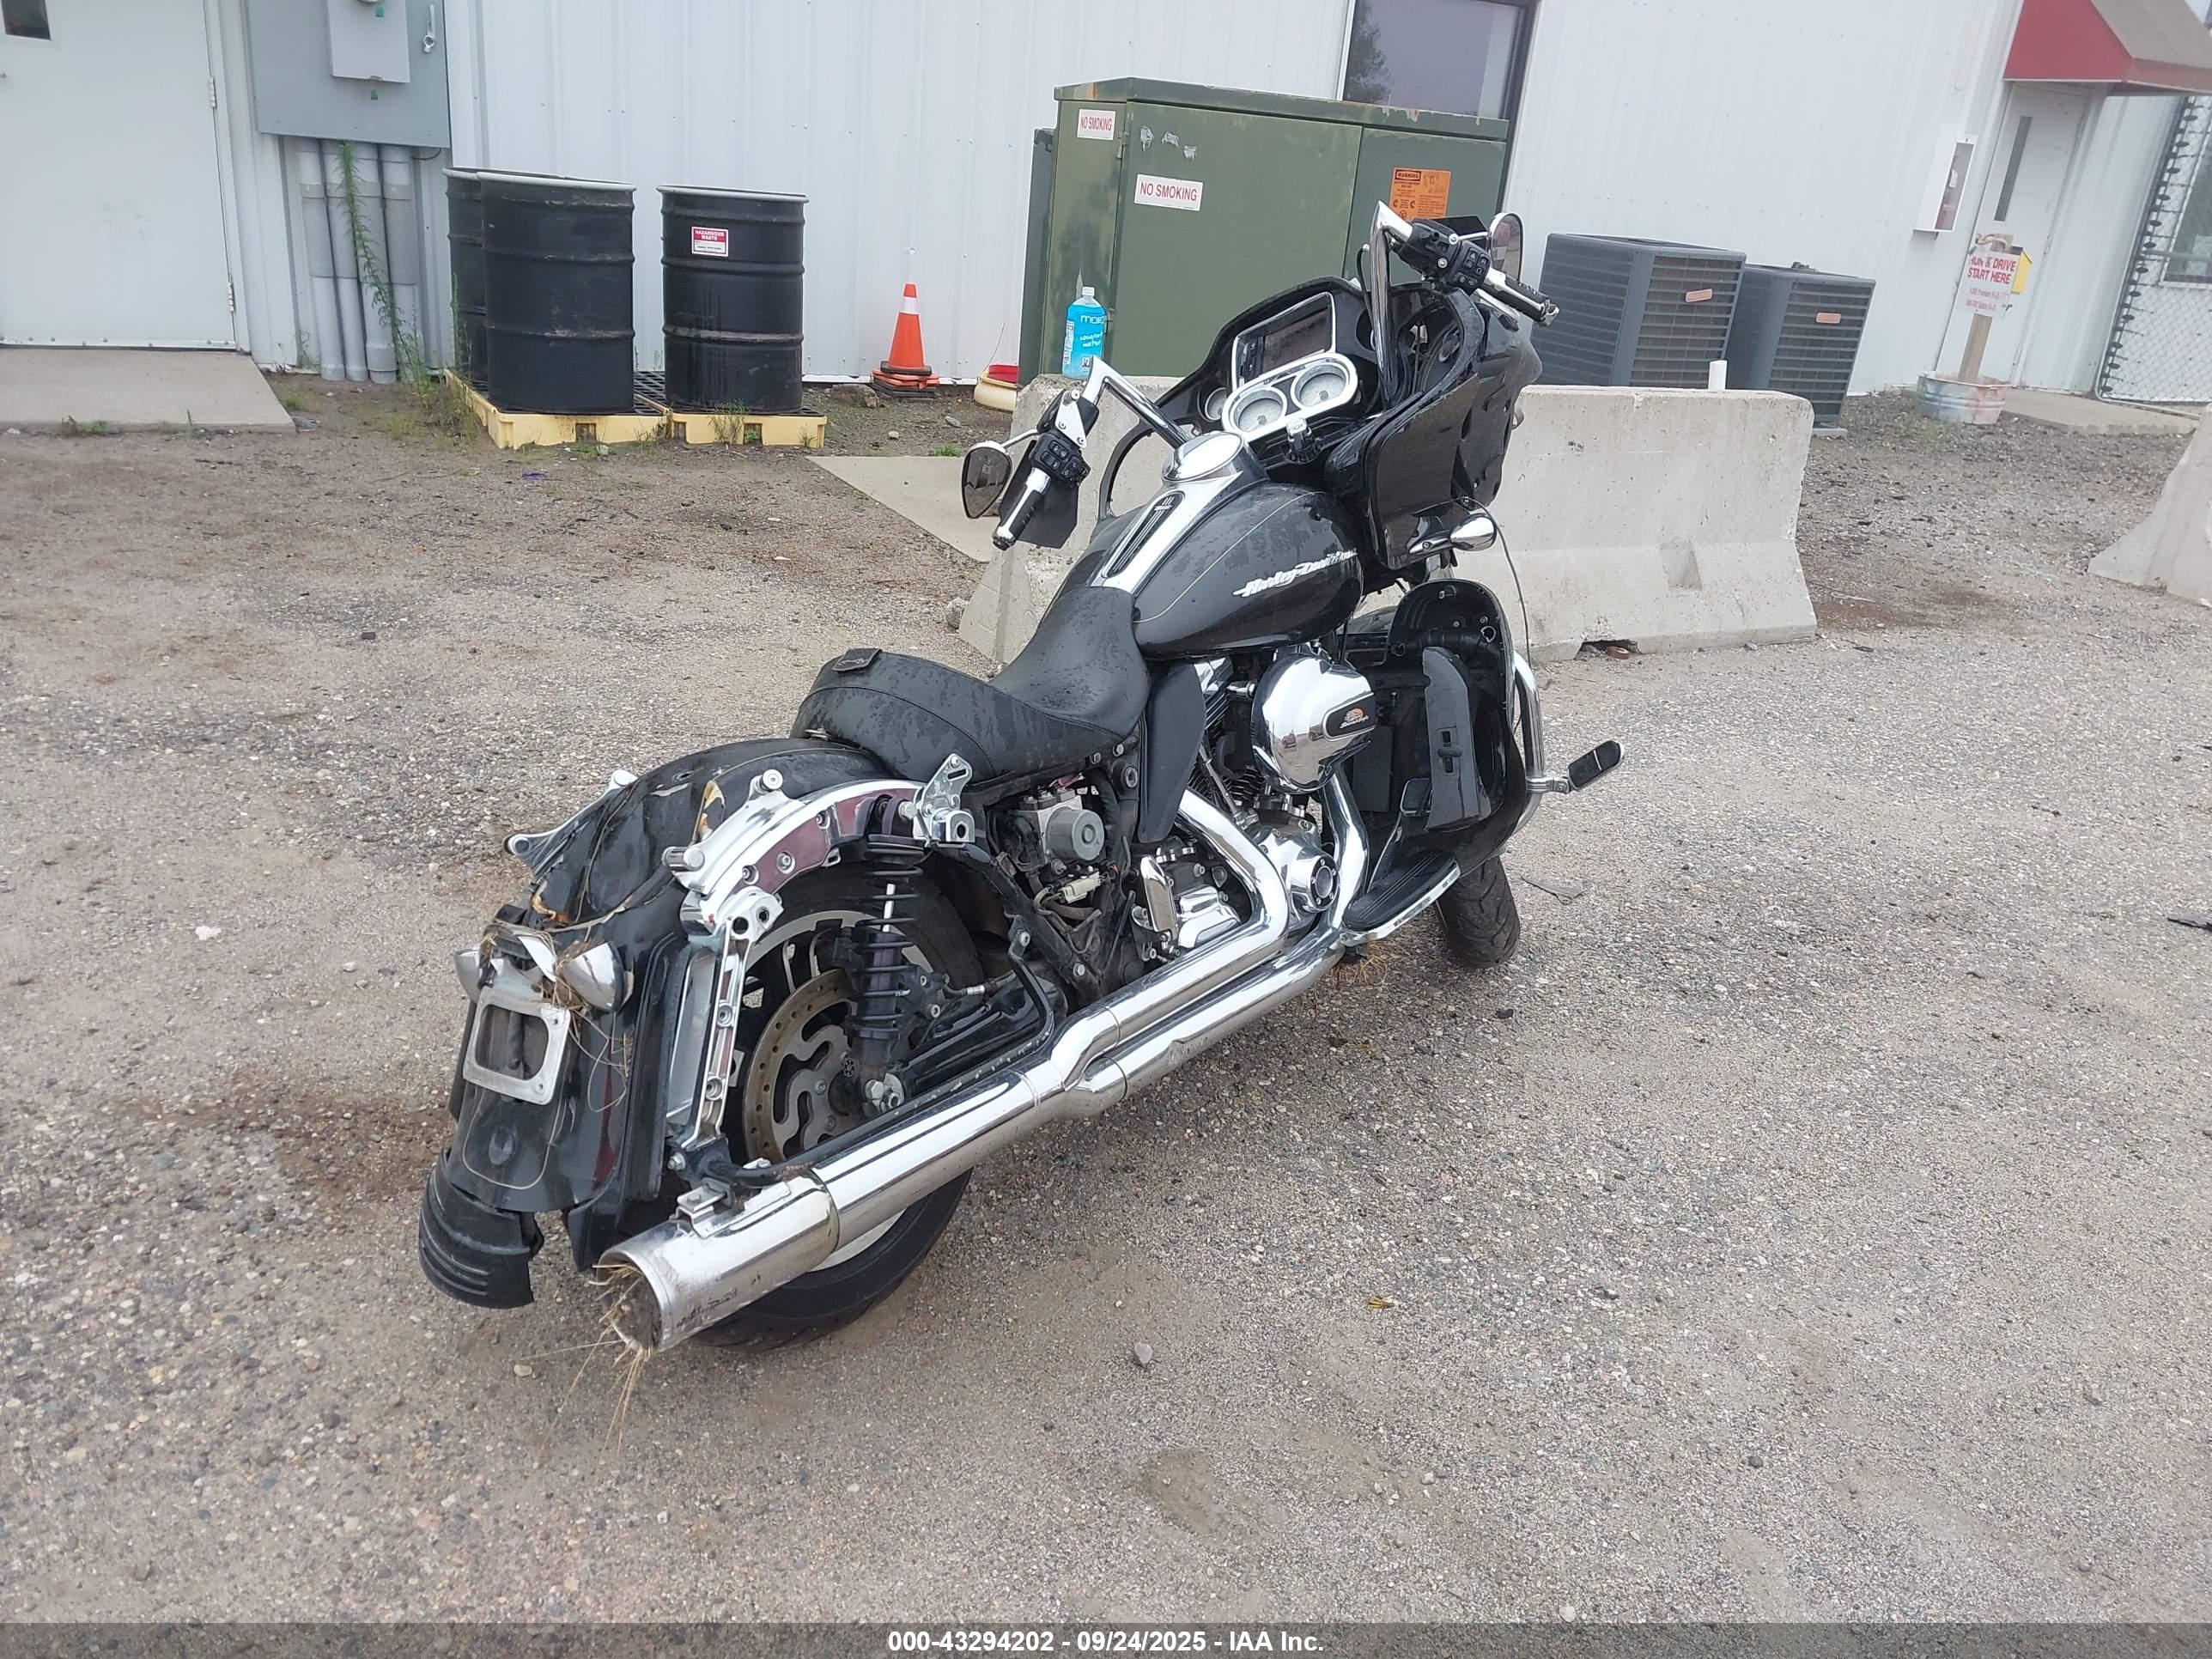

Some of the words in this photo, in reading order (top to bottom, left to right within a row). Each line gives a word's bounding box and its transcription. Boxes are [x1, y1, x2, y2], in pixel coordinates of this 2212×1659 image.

[1080, 116, 1088, 129] NO
[1088, 117, 1113, 131] SMOKING
[1139, 182, 1154, 196] NO
[1155, 184, 1198, 202] SMOKING
[1992, 258, 2016, 272] DRIVE
[1967, 267, 1990, 282] START
[1990, 271, 2012, 285] HERE
